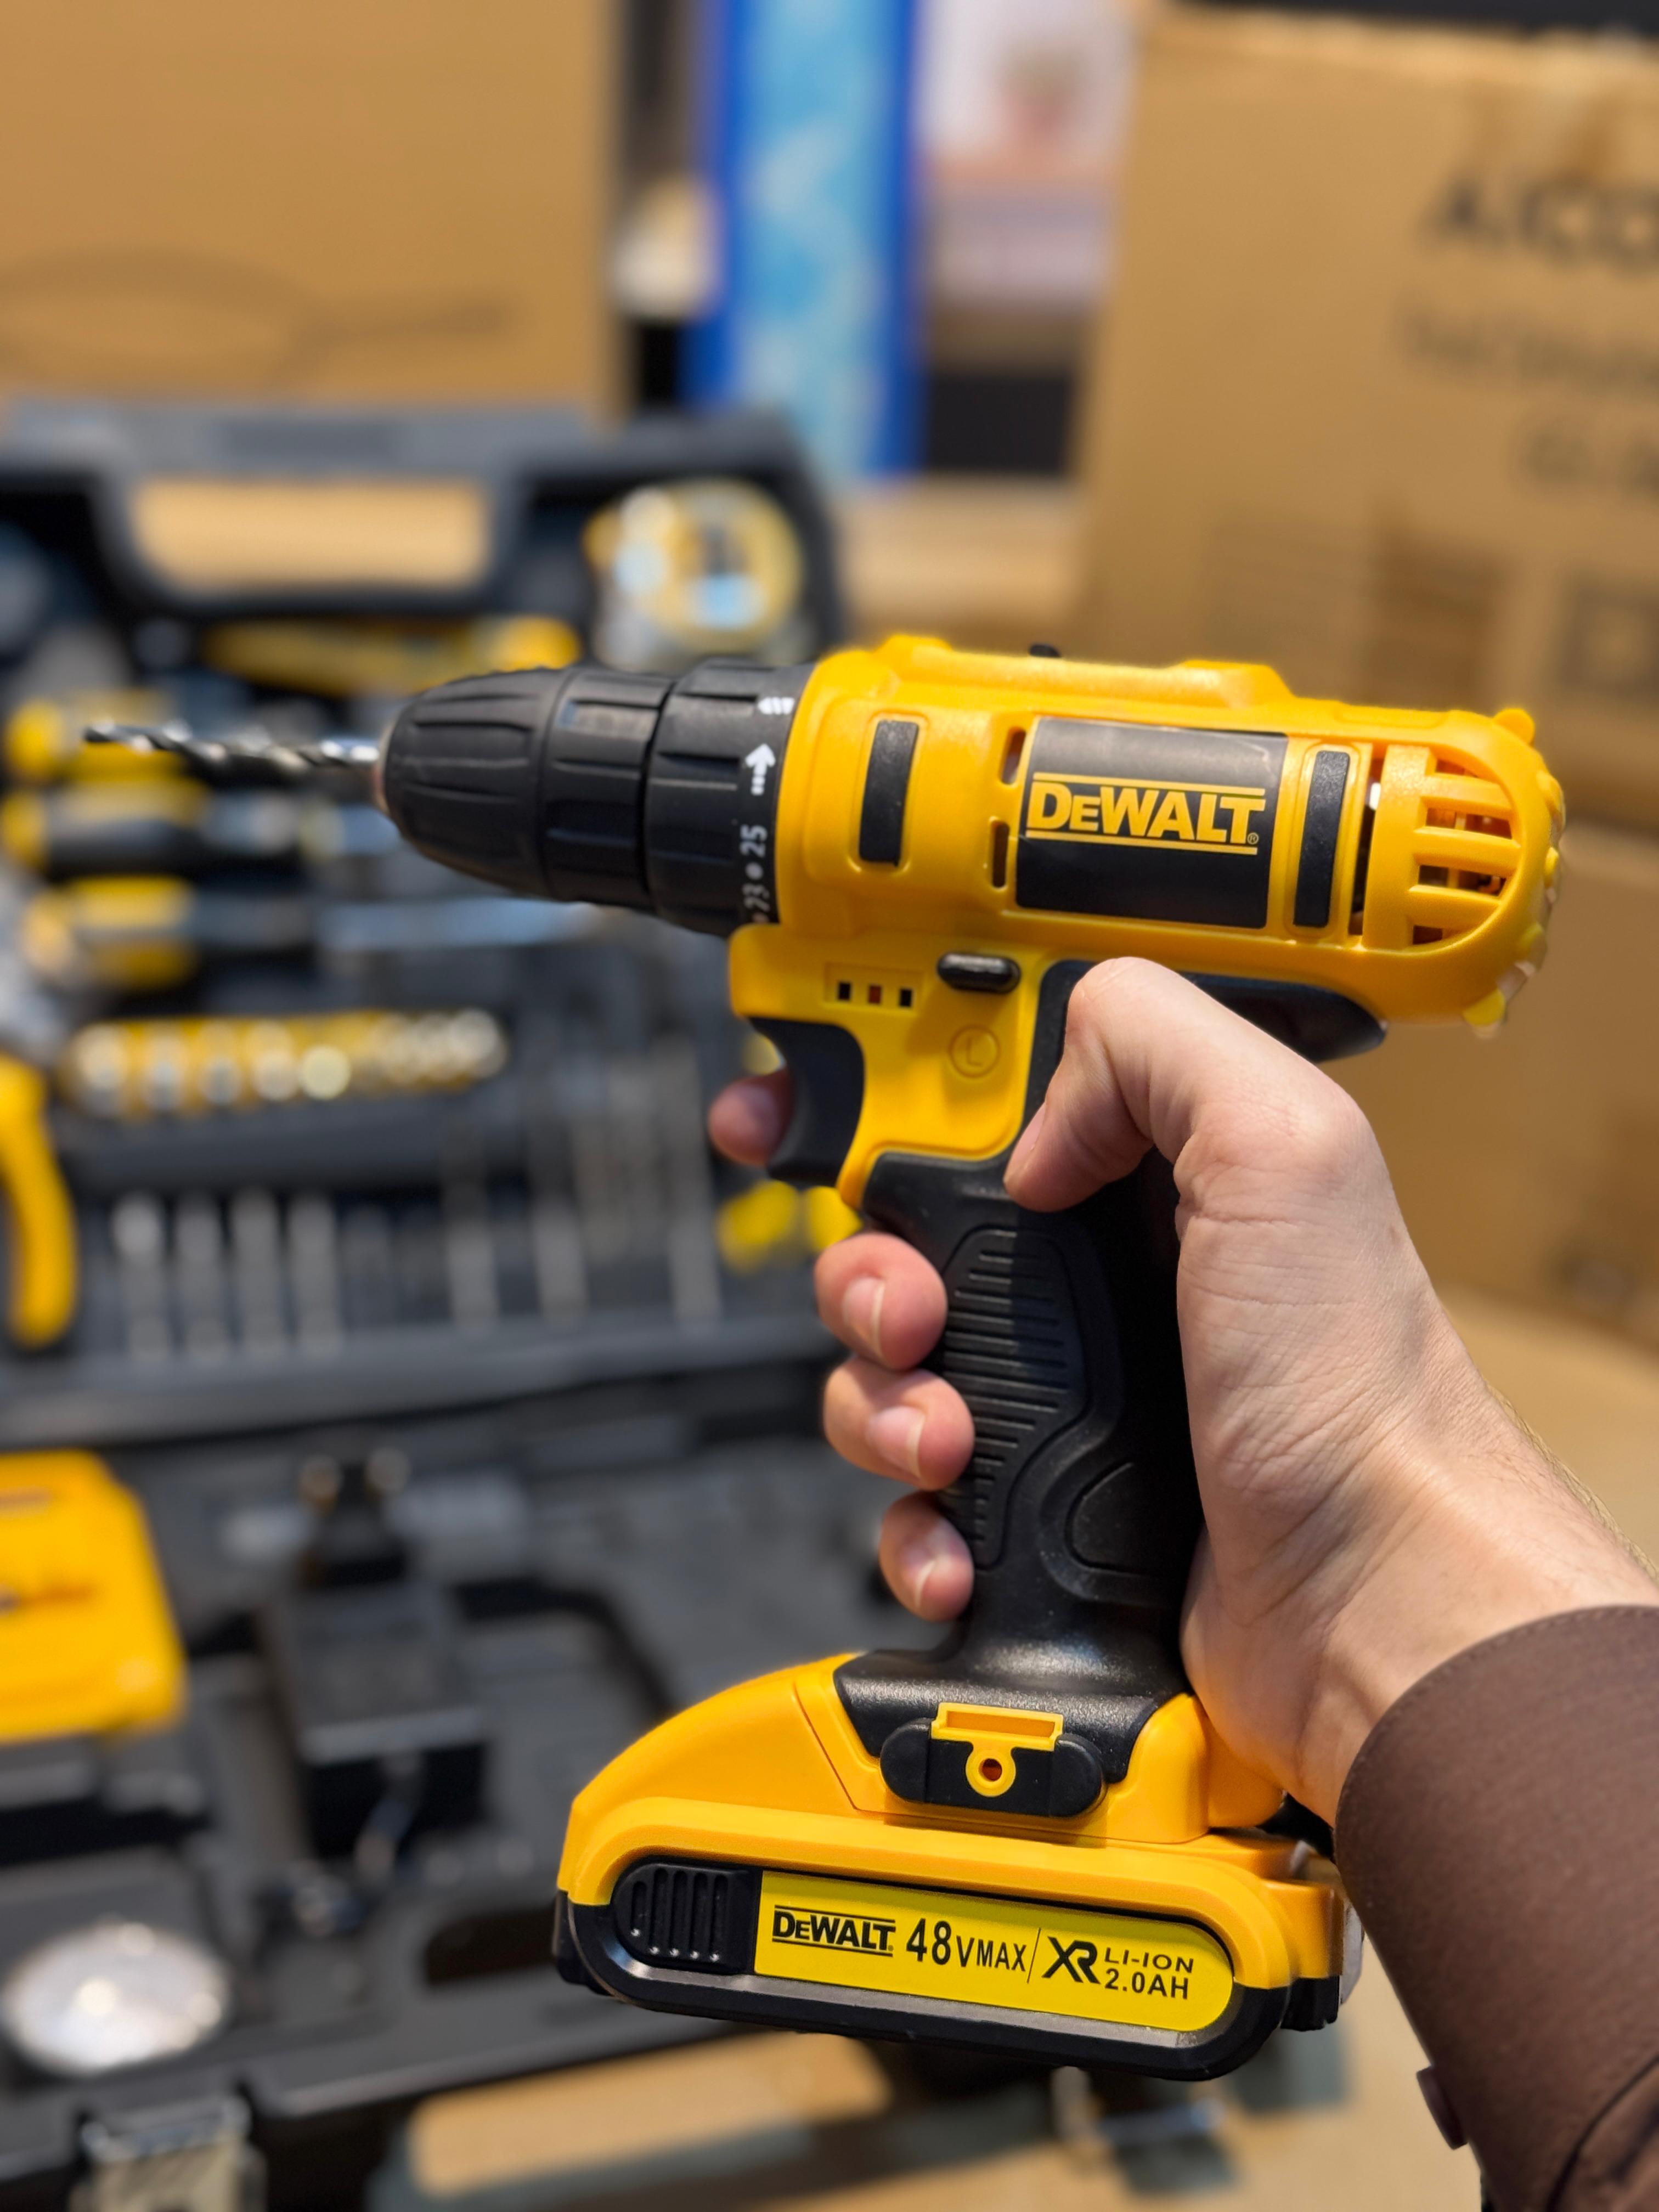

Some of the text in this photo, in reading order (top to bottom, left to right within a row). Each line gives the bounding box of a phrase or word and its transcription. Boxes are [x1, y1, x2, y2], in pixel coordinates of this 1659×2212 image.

[740, 825, 768, 858] 25
[1041, 1936, 1101, 1984] XR
[1104, 1947, 1194, 1973] LI-ION
[1104, 1968, 1189, 2000] 2.0AH
